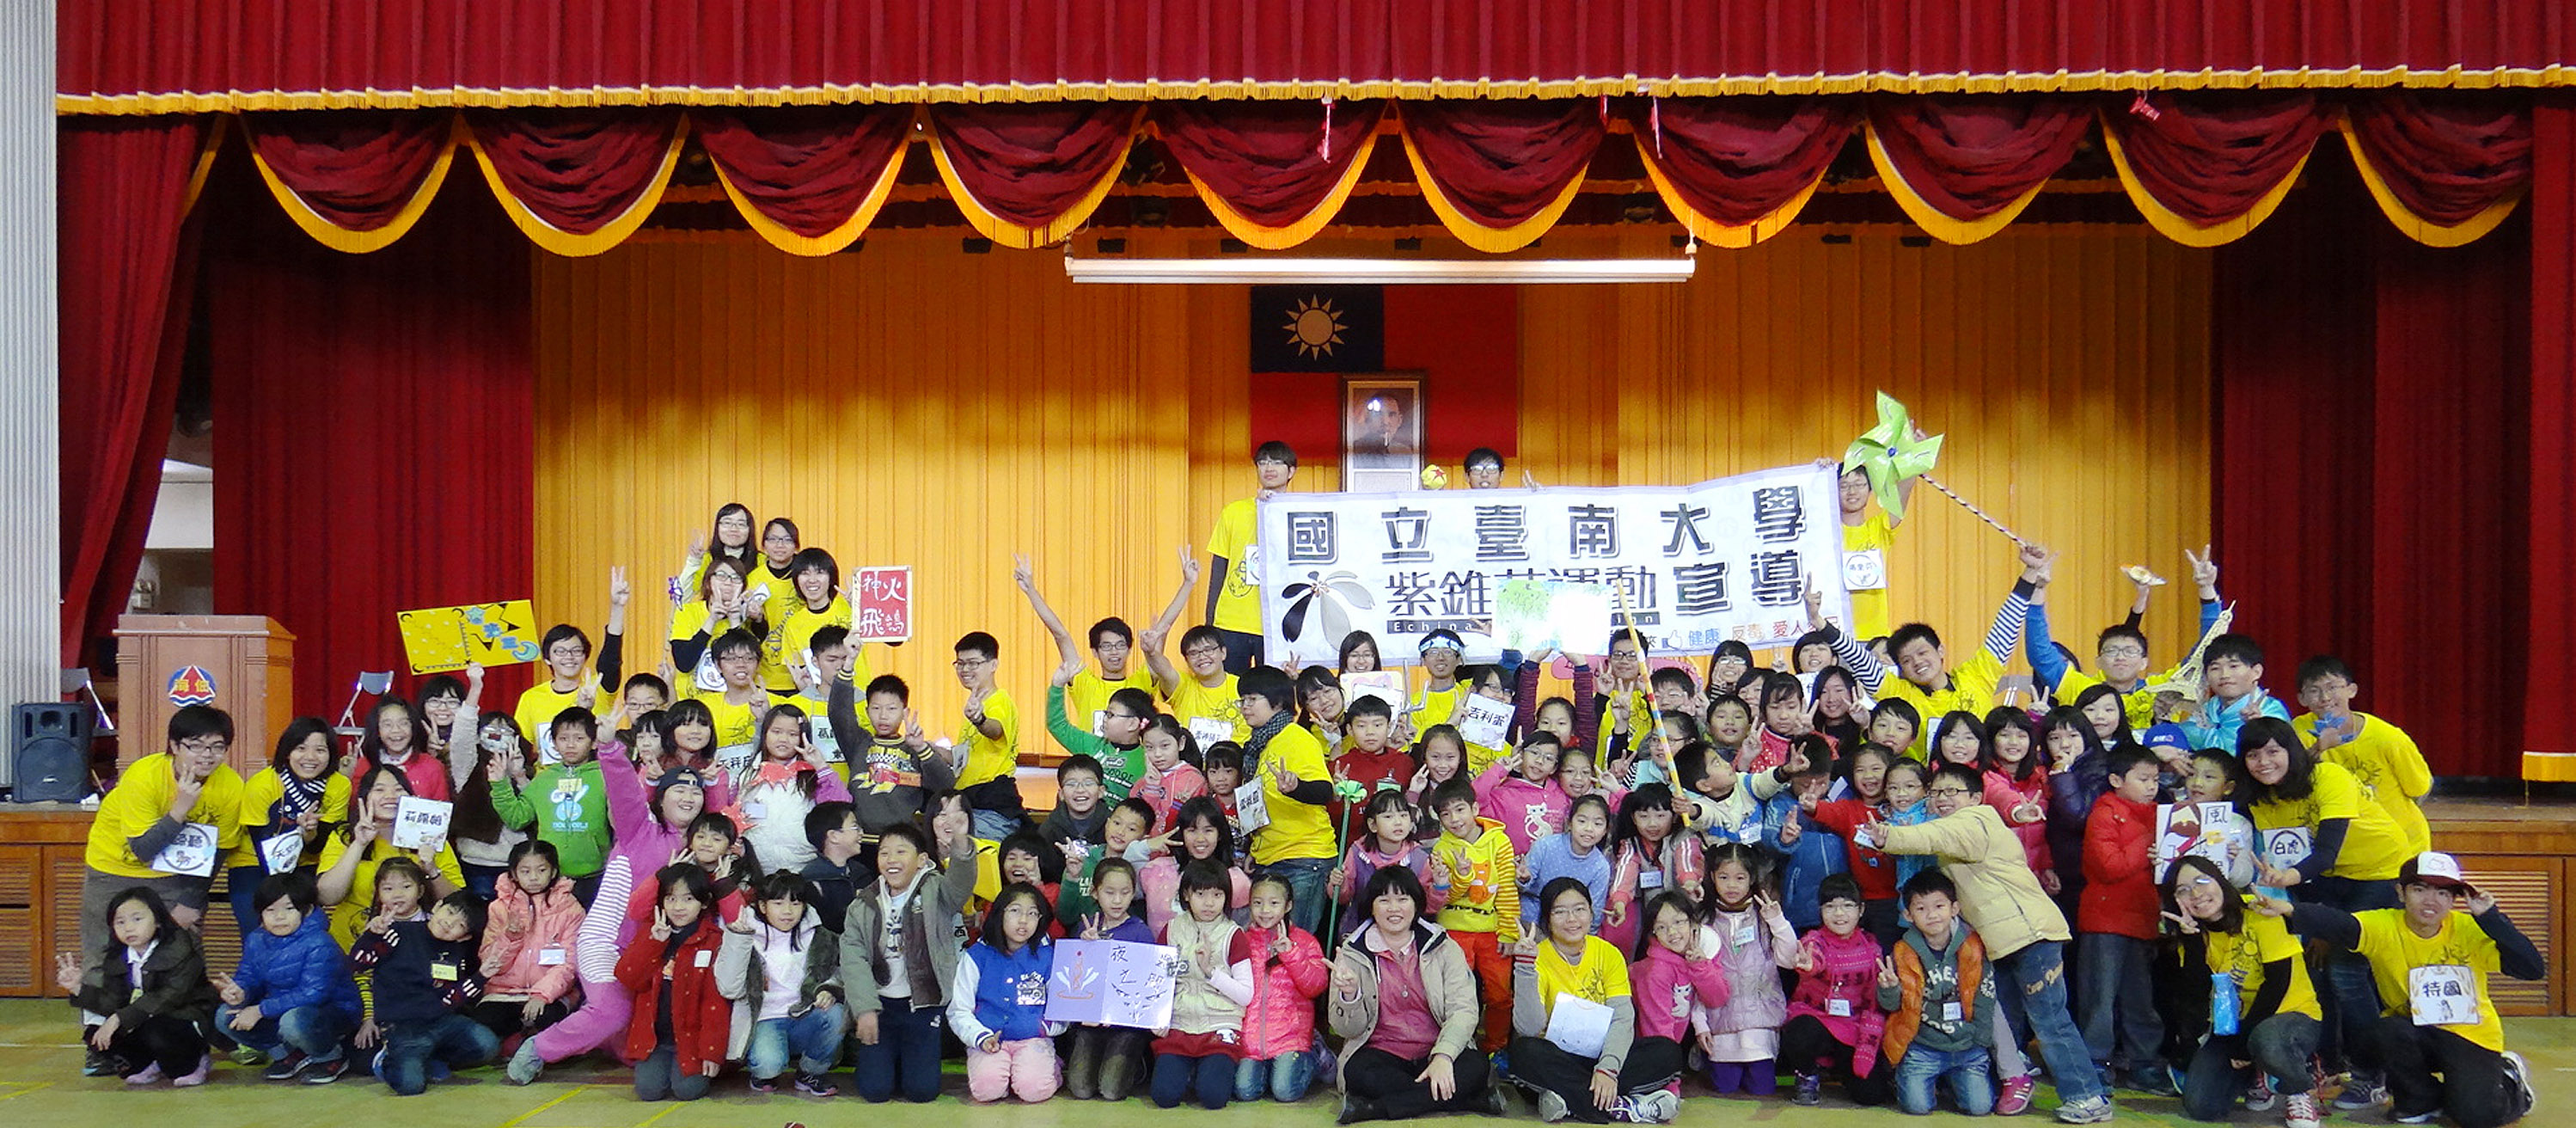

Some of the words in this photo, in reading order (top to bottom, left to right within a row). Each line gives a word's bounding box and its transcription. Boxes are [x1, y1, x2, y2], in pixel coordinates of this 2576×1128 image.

[1288, 486, 1804, 561] 國立臺南大學
[1386, 565, 1656, 616] 紫錐動
[1689, 627, 1719, 645] 健康
[1732, 622, 1763, 641] 反毒
